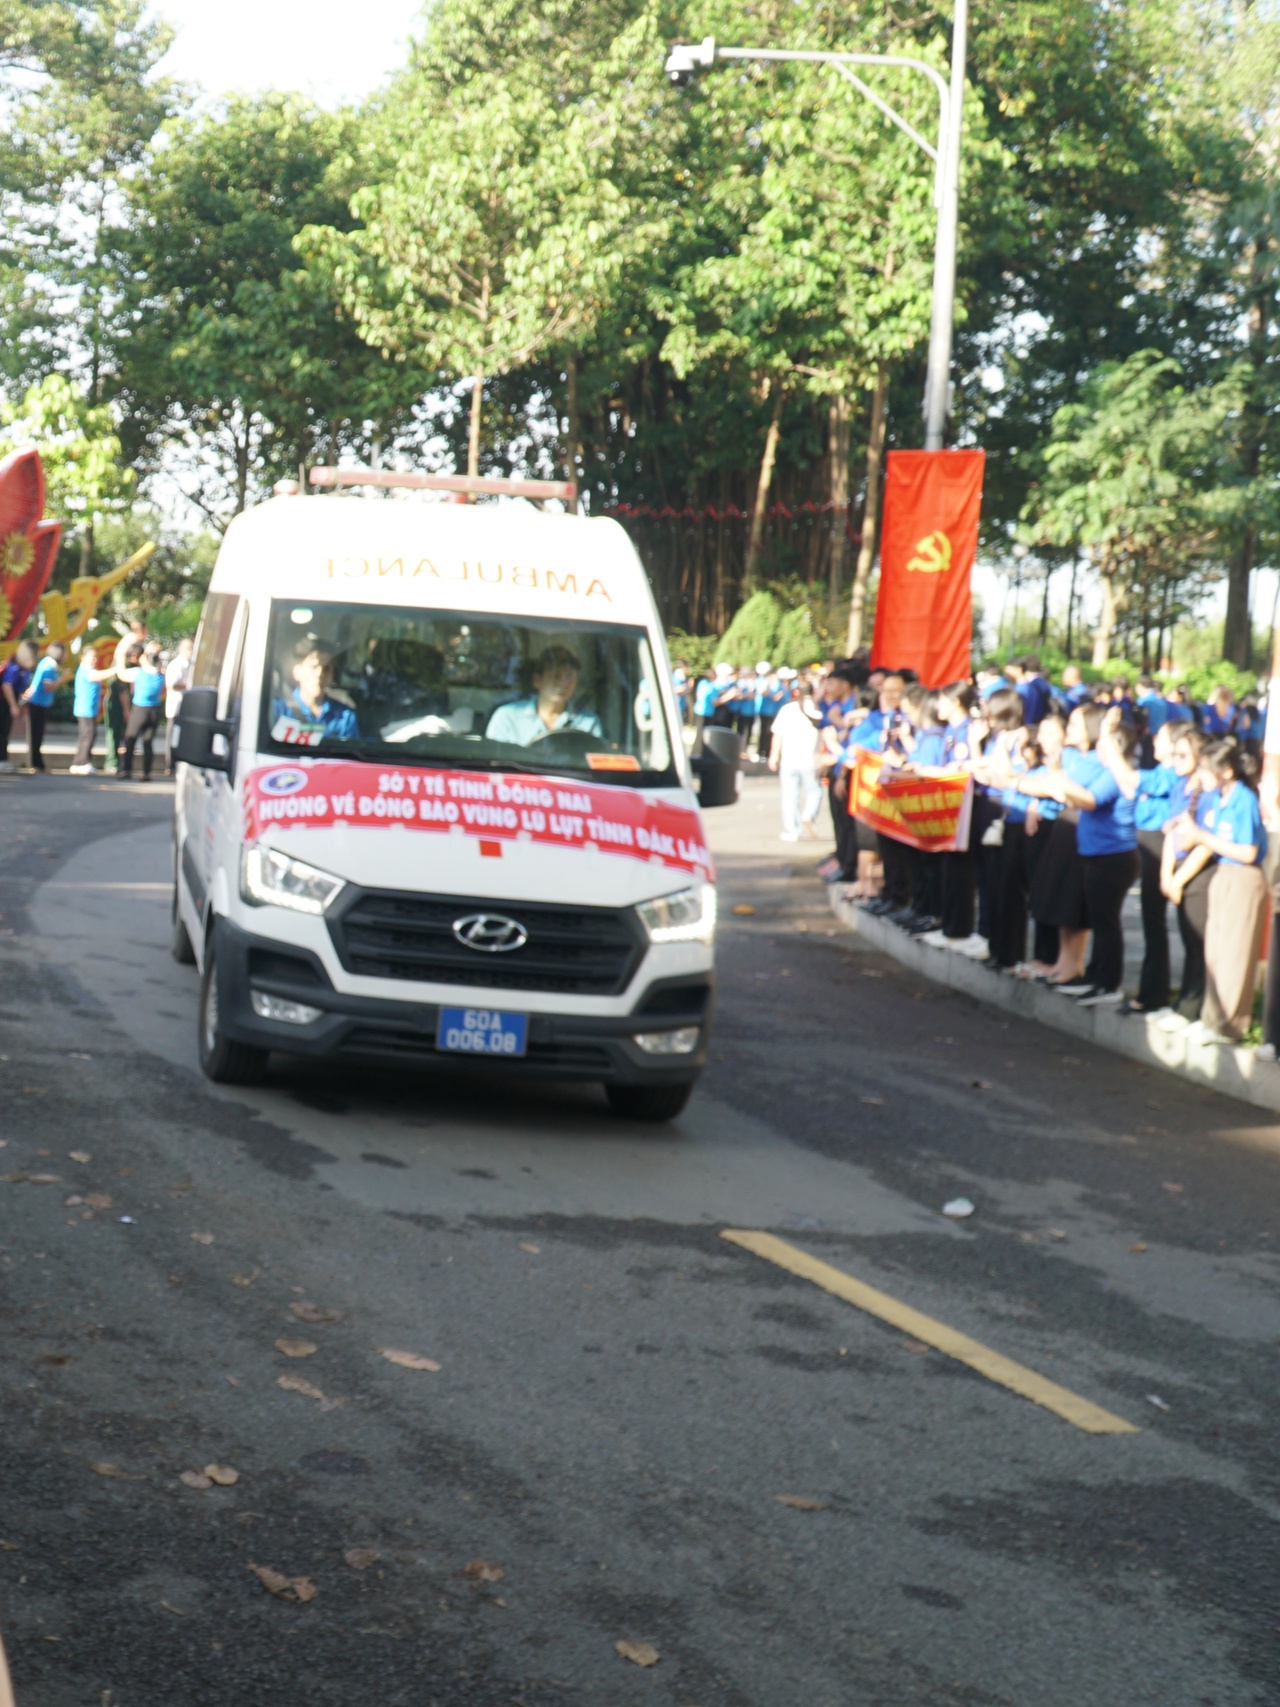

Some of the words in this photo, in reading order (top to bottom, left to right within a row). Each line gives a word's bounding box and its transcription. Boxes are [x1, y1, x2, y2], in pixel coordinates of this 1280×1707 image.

[407, 775, 420, 794] Y
[557, 790, 592, 813] NAI
[464, 1009, 502, 1031] 60A
[446, 1028, 517, 1053] 006.08
